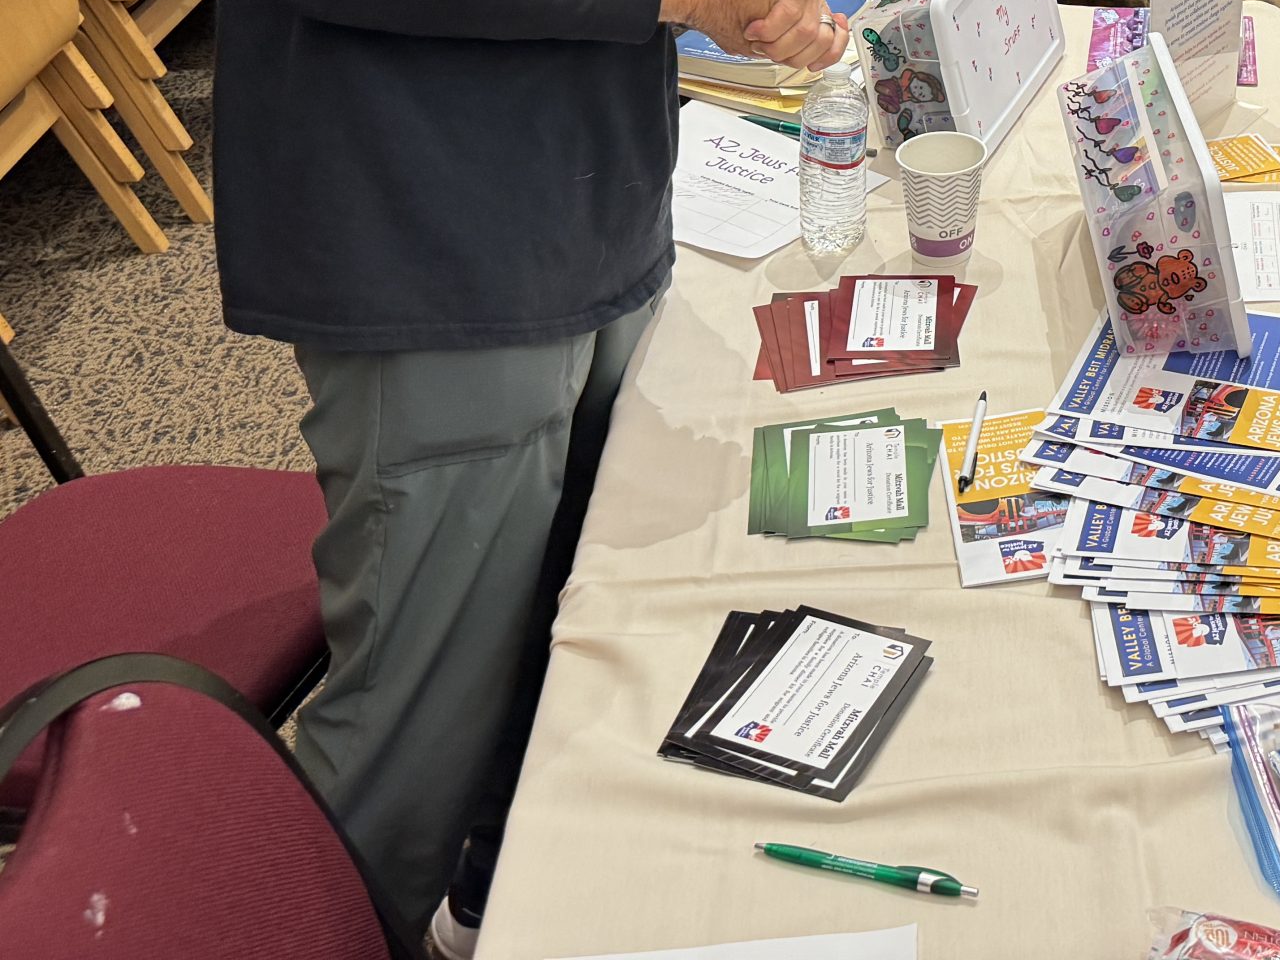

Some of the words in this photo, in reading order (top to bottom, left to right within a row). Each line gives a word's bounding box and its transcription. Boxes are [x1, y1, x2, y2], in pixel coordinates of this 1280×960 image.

[704, 136, 740, 152] AZ
[738, 148, 787, 170] Jews
[706, 156, 775, 184] Justice
[938, 227, 963, 239] OFF
[1068, 379, 1092, 408] VALLEY
[1086, 360, 1102, 378] BEIT
[1095, 328, 1116, 359] MIDRAS
[1084, 388, 1096, 406] Global
[1094, 376, 1104, 392] Center
[1246, 395, 1279, 444] ARIZONA
[967, 471, 1036, 491] RIZON
[866, 486, 874, 505] Justice
[896, 498, 904, 510] Mall
[1086, 513, 1106, 548] VALLEY
[1102, 526, 1112, 543] Global
[1136, 615, 1147, 638] Center
[1121, 626, 1142, 670] VALLEY
[1142, 638, 1152, 661] Global
[836, 652, 864, 682] Arizona
[860, 664, 882, 688] CHAI
[823, 681, 842, 700] Jews
[814, 699, 830, 712] for
[827, 702, 852, 729] Donation
[794, 710, 820, 738] Justice
[834, 708, 862, 741] Mitzvah
[804, 728, 832, 758] Certificate
[818, 740, 838, 760] Mall
